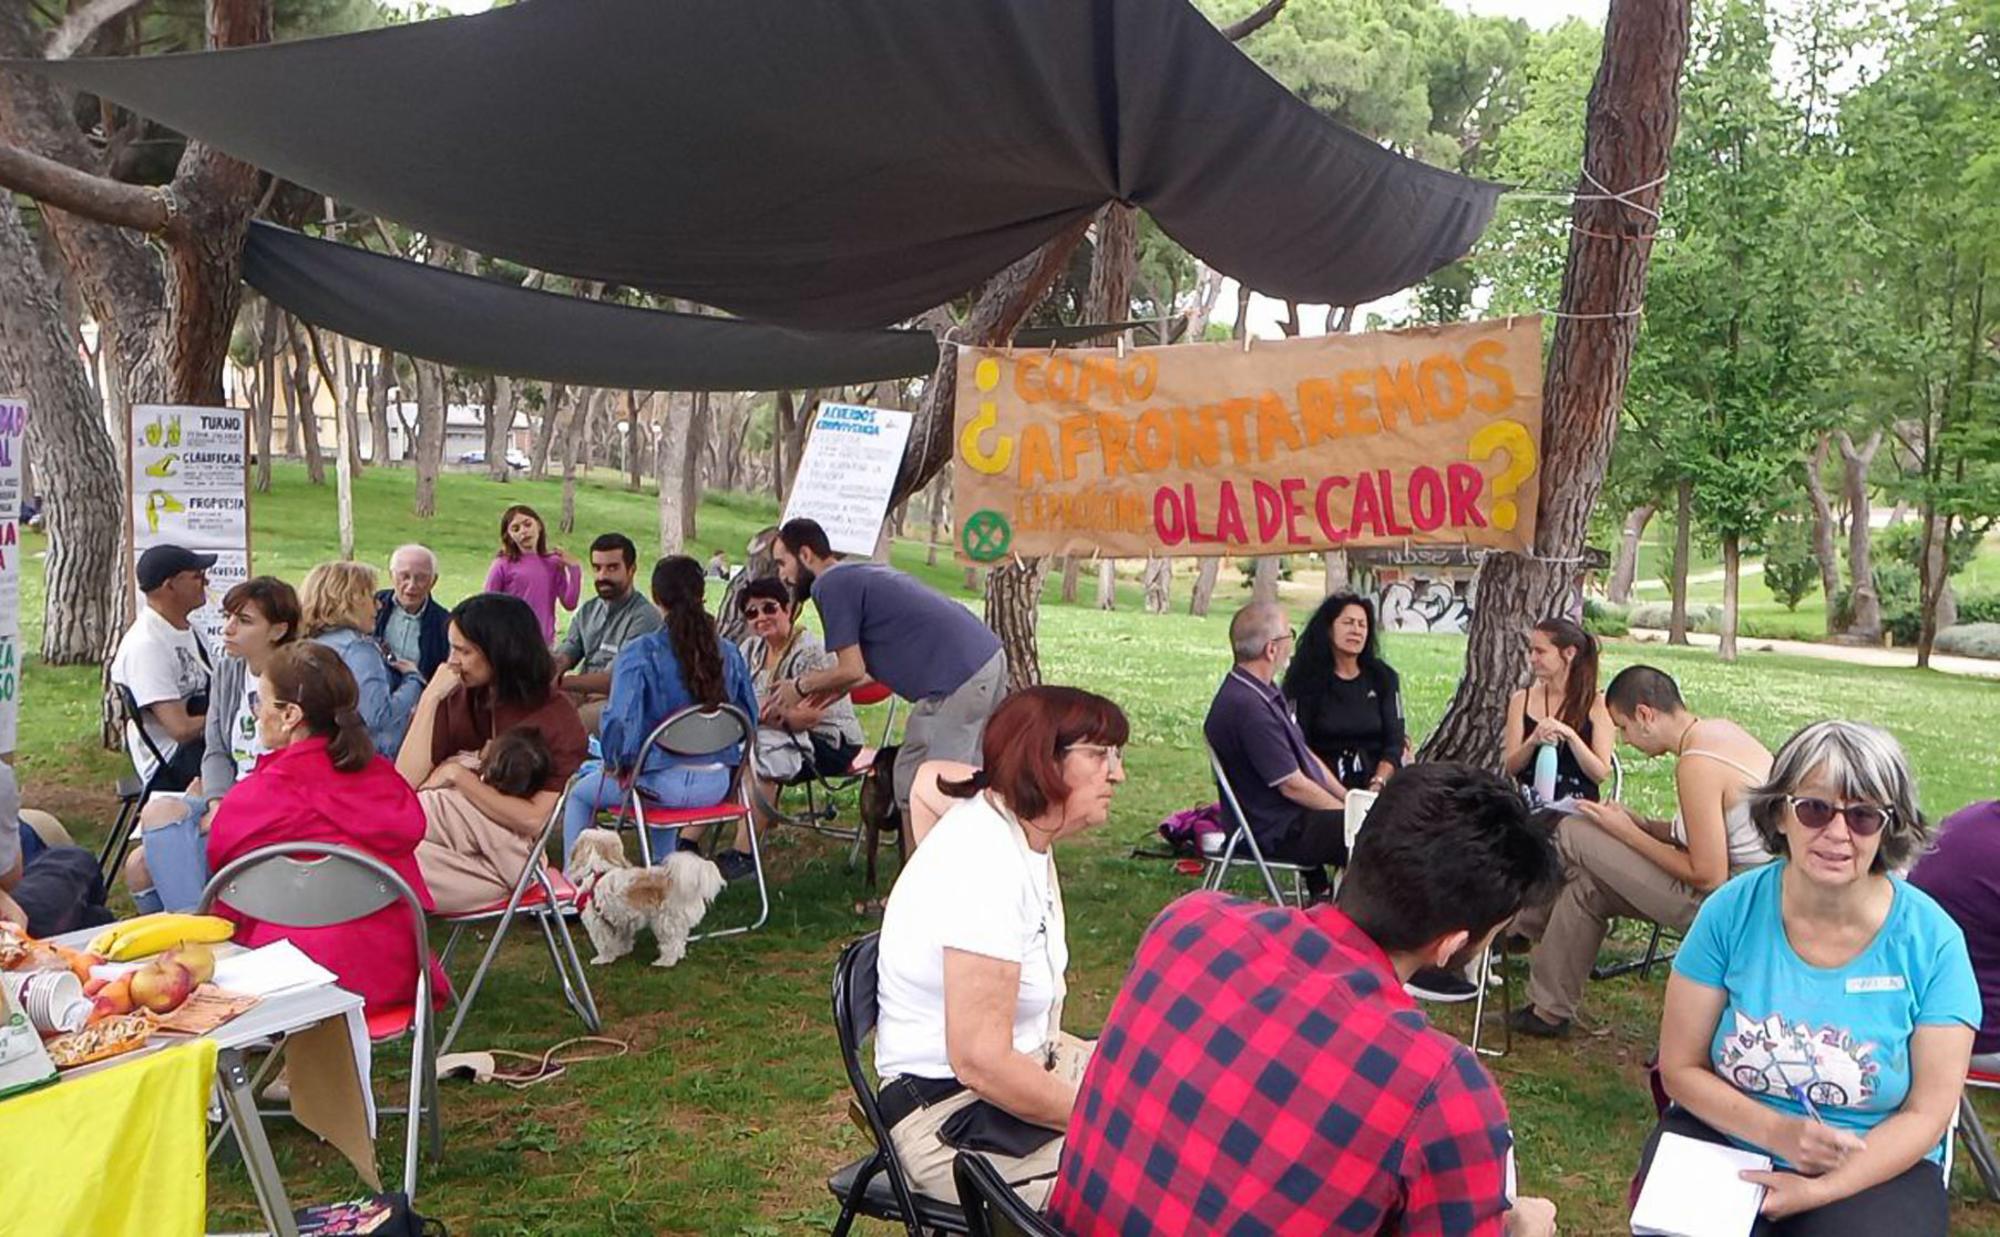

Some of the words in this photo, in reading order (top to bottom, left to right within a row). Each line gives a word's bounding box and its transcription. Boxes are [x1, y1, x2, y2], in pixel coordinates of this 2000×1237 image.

[200, 415, 240, 431] TURNO
[1018, 341, 1516, 489] AFRONTAREMOS
[1153, 480, 1248, 546] OLA
[1253, 478, 1312, 545] DE
